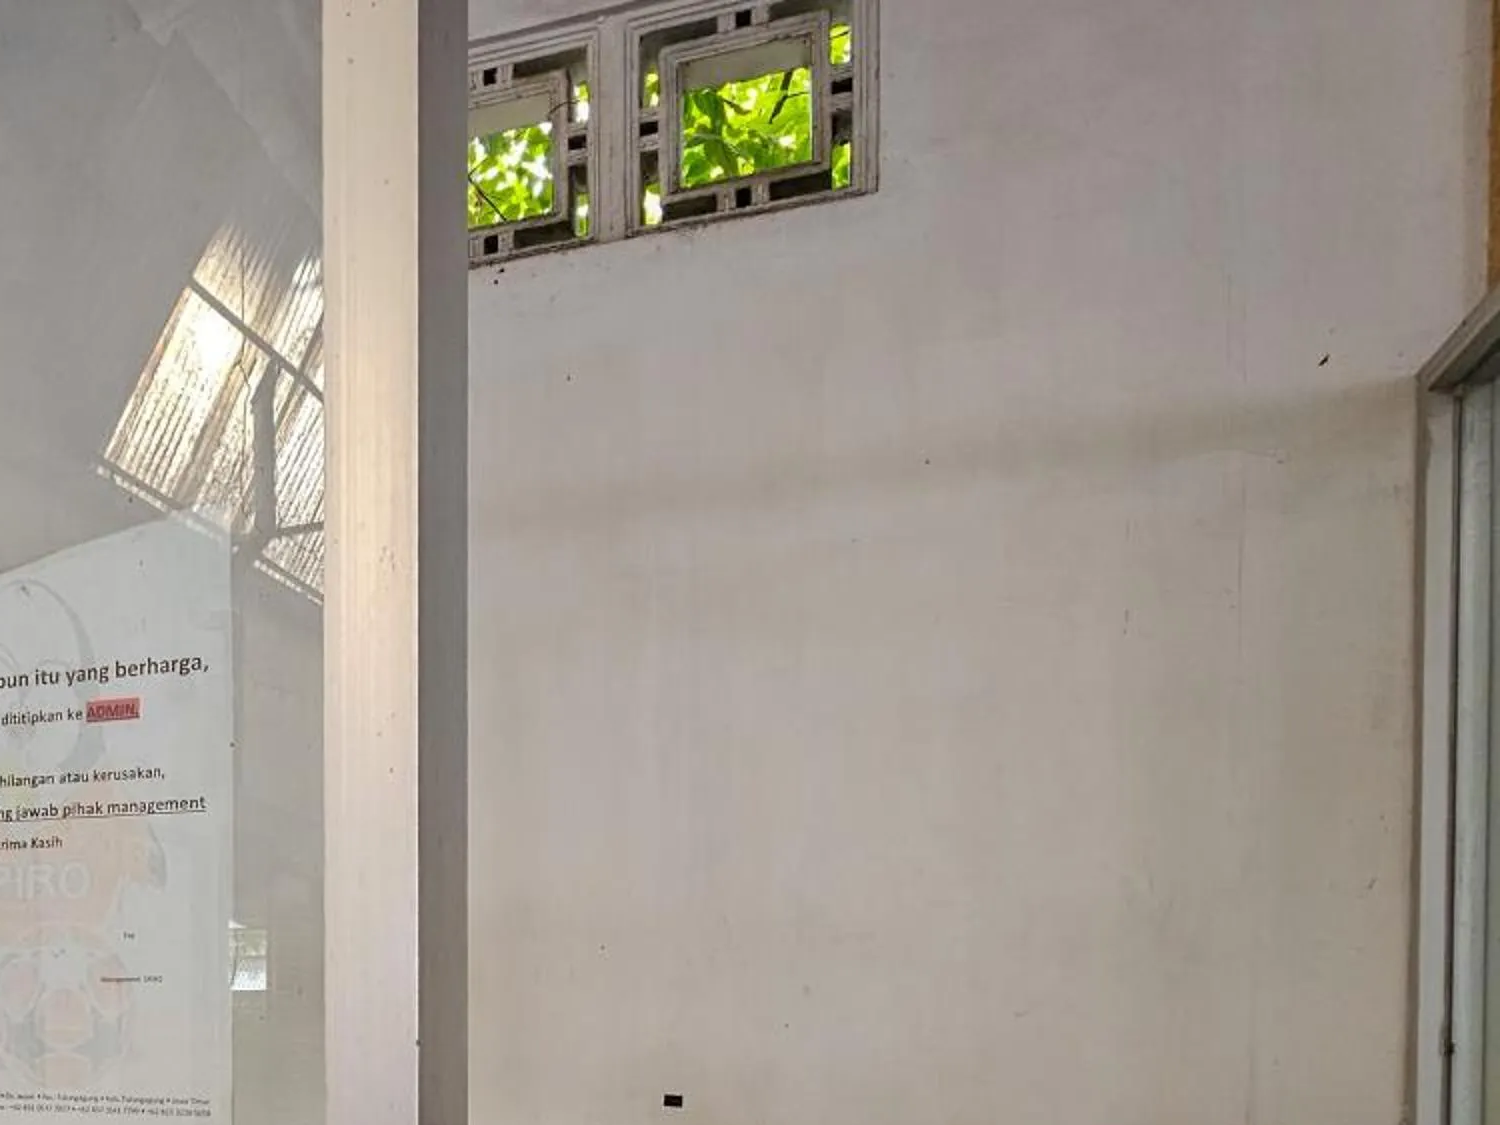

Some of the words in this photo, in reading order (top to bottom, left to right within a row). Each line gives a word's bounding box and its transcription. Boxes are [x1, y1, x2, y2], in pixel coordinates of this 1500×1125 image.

[35, 669, 60, 686] itu
[65, 665, 109, 688] yang
[115, 655, 209, 680] berharga,
[1, 708, 64, 728] dititipkan
[67, 708, 83, 721] ke
[59, 771, 89, 784] atau
[92, 766, 165, 783] kerusakan,
[16, 801, 59, 821] jawab
[62, 798, 103, 818] pihak
[107, 795, 206, 817] management
[31, 836, 63, 850] Kasih
